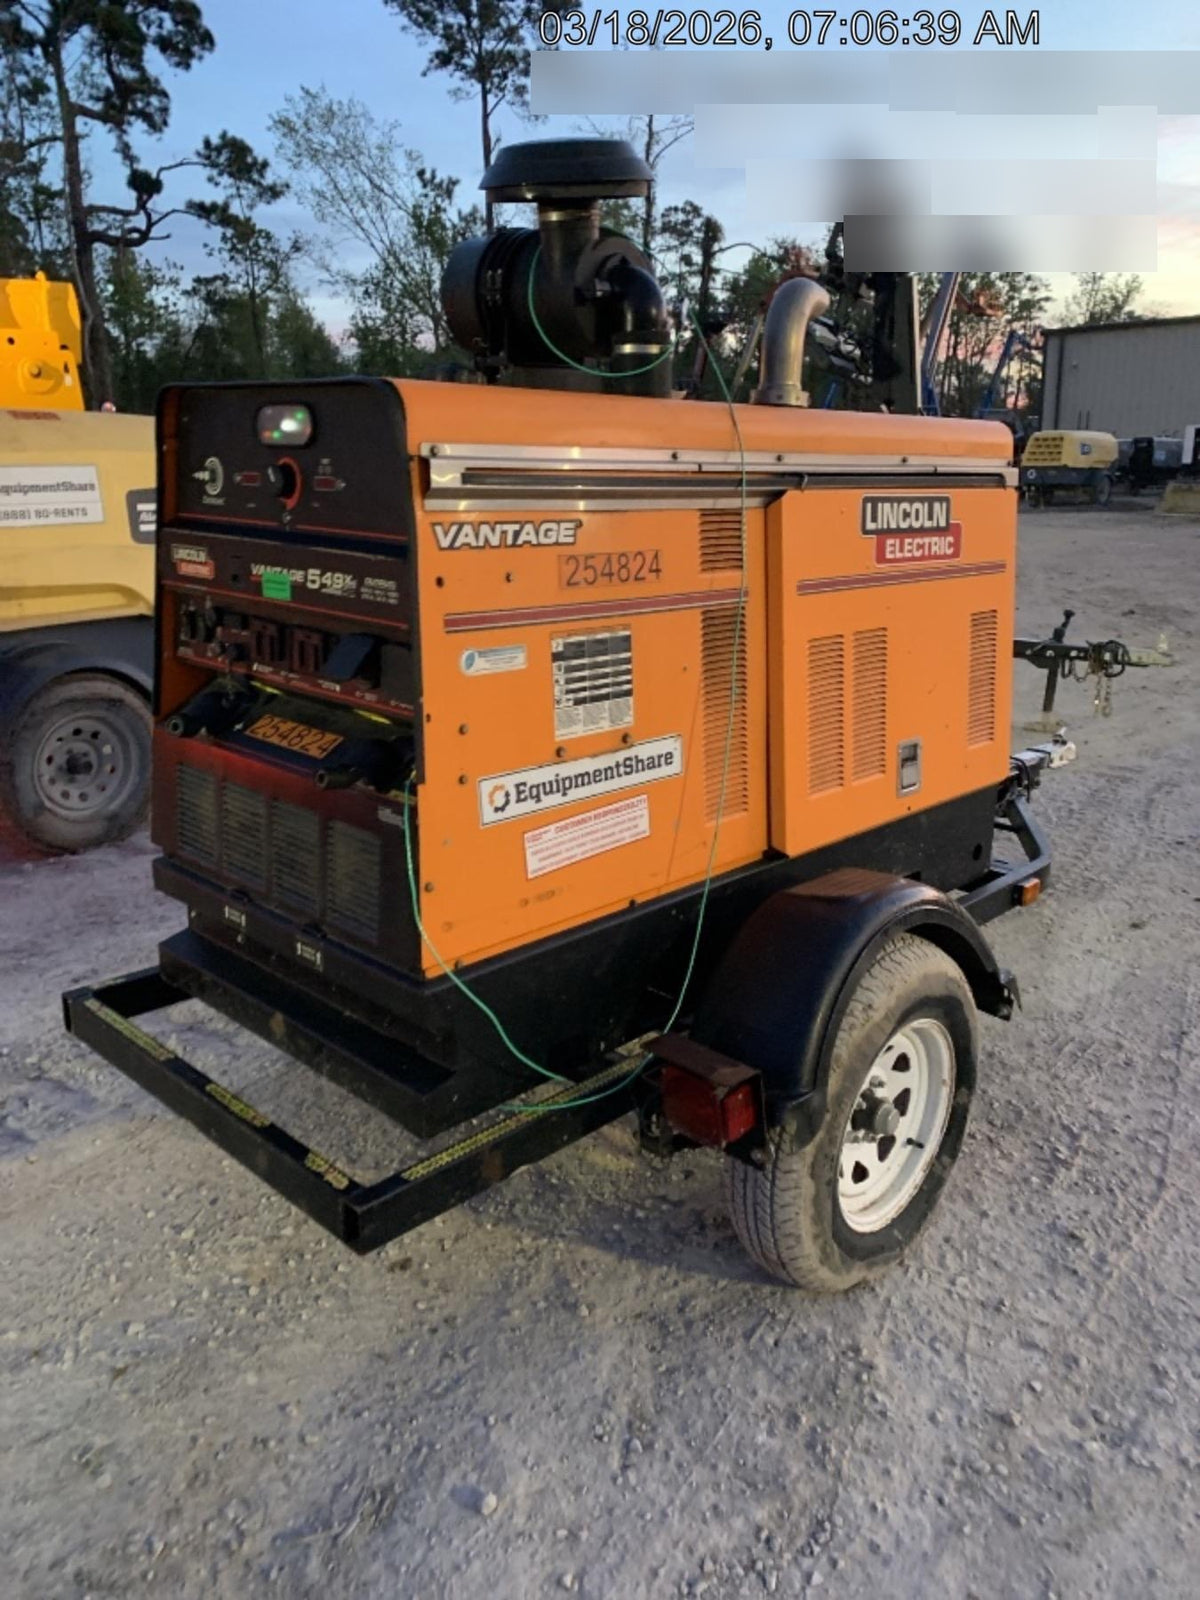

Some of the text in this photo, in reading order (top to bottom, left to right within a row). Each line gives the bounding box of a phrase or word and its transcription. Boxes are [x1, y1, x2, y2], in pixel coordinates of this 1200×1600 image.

[0, 481, 96, 496] quipmentShare
[865, 501, 947, 530] LINCOLN
[431, 519, 578, 550] VANTAGE
[885, 536, 954, 559] ELECTRIC
[566, 550, 662, 587] 254824
[249, 715, 341, 755] 254824
[514, 750, 674, 804] EquipmentShare
